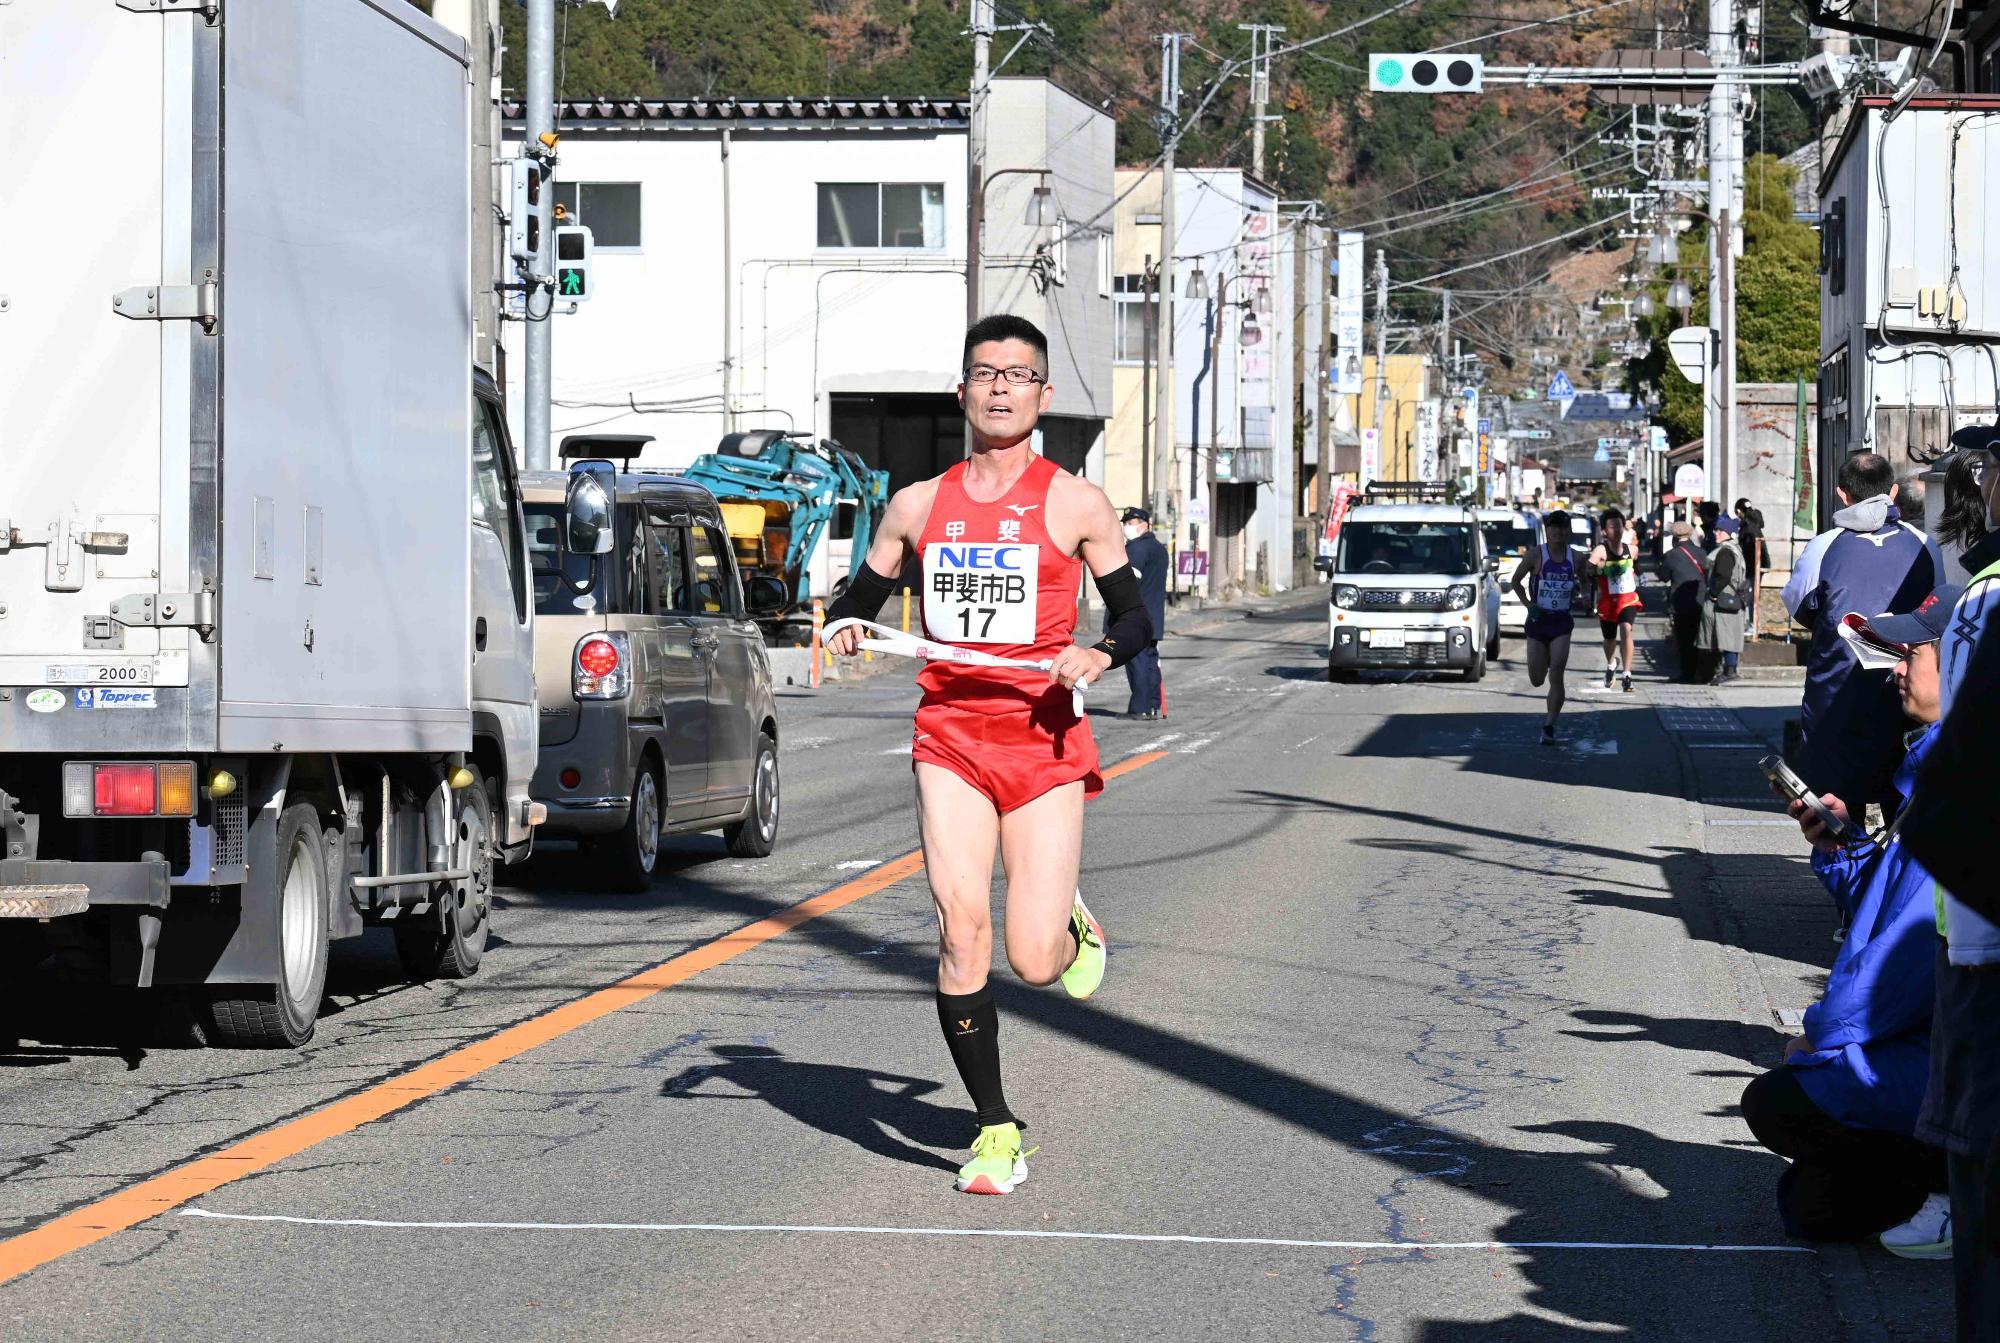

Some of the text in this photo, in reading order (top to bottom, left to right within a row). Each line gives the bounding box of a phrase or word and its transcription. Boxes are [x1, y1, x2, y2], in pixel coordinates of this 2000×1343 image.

[939, 547, 1022, 570] NEC
[933, 572, 1026, 604] 甲斐市B
[1543, 581, 1569, 590] NEC
[1551, 599, 1558, 609] 9
[957, 607, 997, 638] 17
[99, 667, 137, 680] 2000
[99, 689, 152, 703] Toprec
